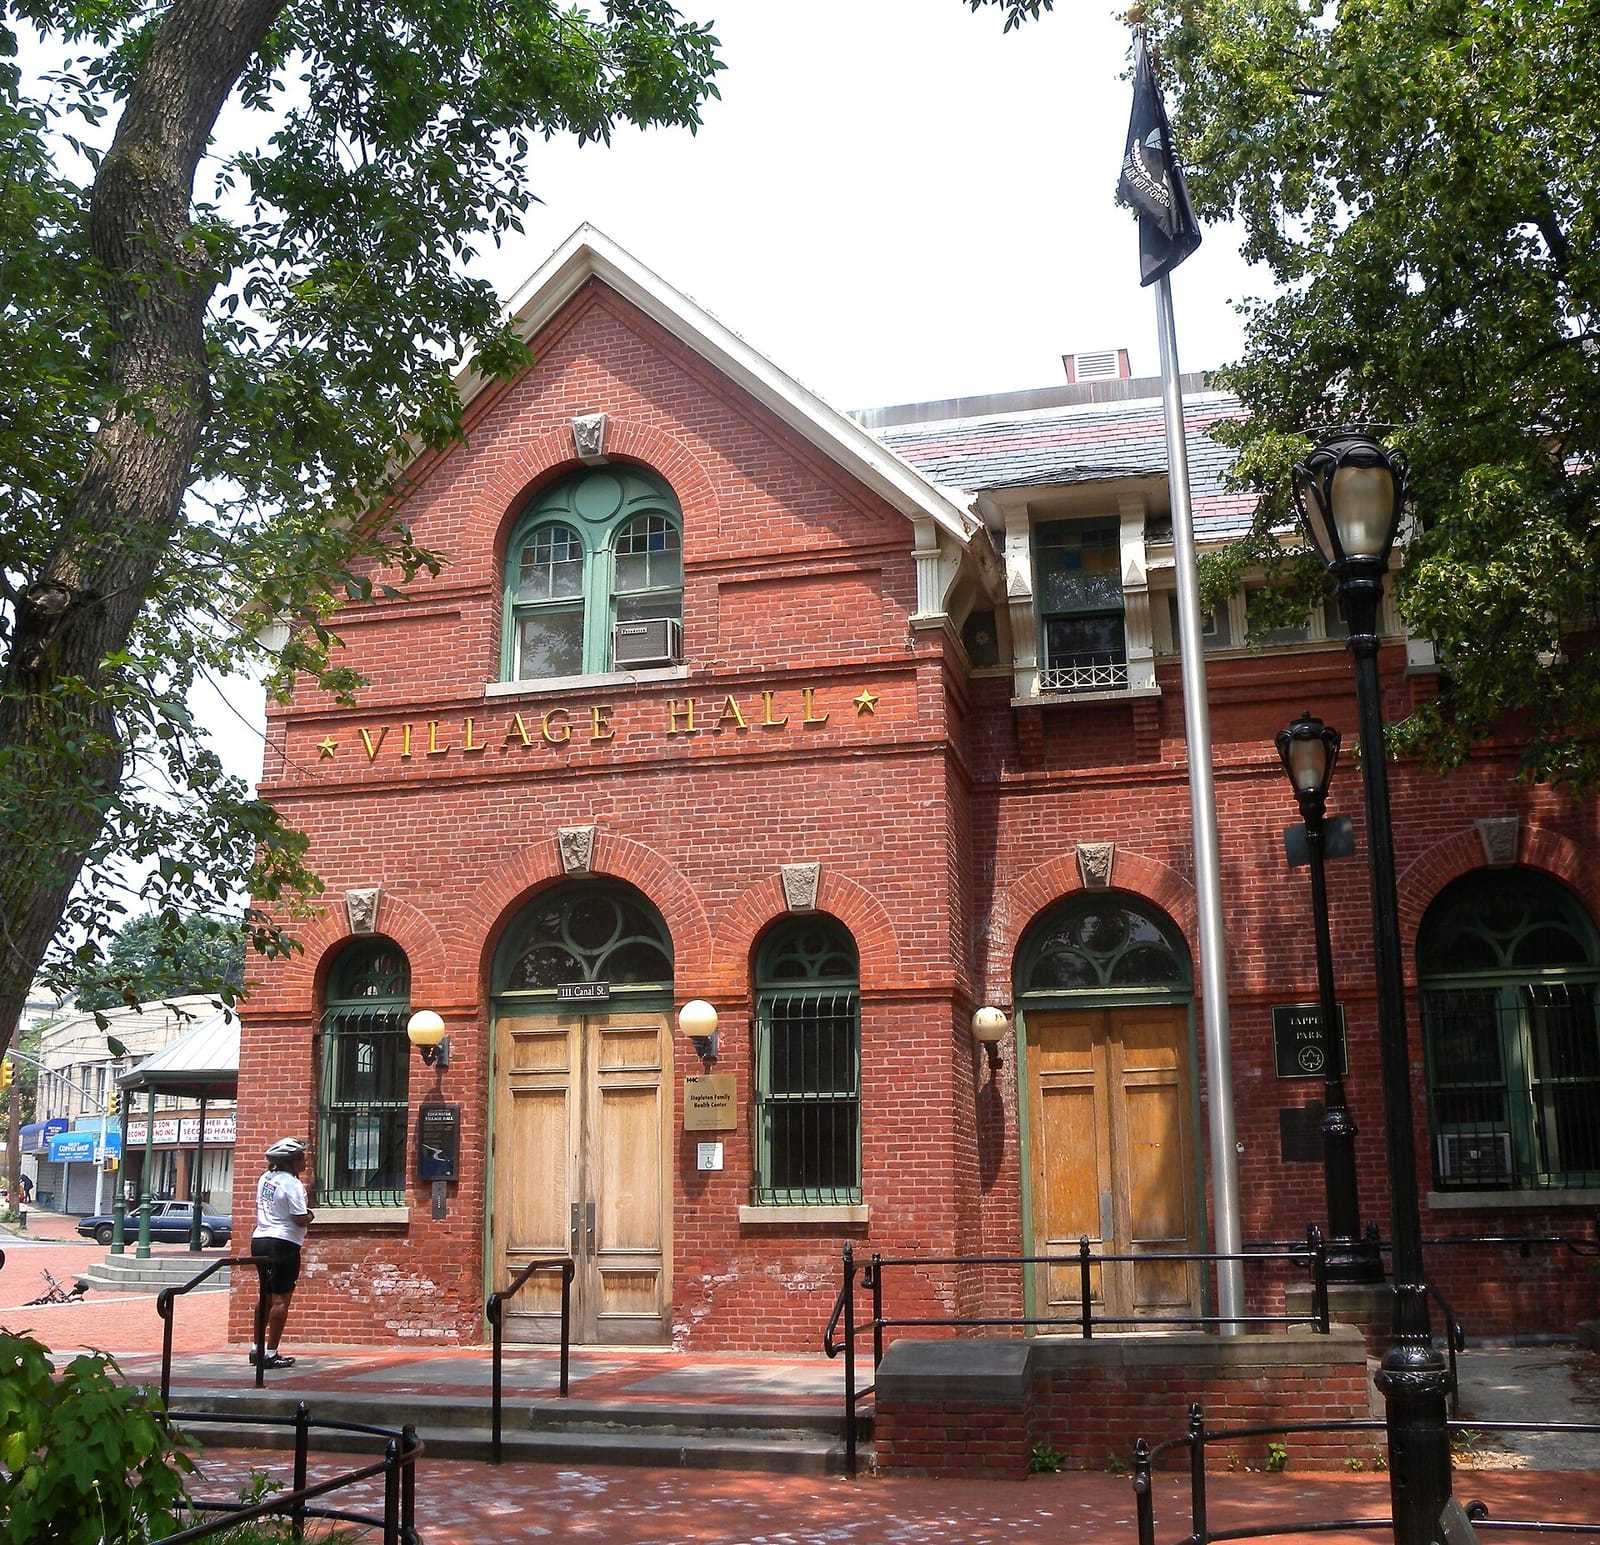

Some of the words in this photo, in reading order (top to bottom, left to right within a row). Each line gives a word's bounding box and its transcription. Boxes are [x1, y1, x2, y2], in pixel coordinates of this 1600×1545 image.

[1124, 167, 1138, 181] ARE
[1131, 174, 1149, 190] NOT
[1145, 186, 1171, 208] FORGO
[357, 704, 616, 762] VILLAGE
[666, 686, 831, 736] HALL
[561, 988, 572, 997] 111
[574, 986, 595, 997] Canal
[596, 985, 606, 996] St.
[1290, 1016, 1323, 1025] TAPPE
[1296, 1032, 1323, 1040] PARK
[714, 1093, 730, 1101] Family
[131, 1121, 149, 1129] FATHE
[192, 1119, 222, 1127] FAHER
